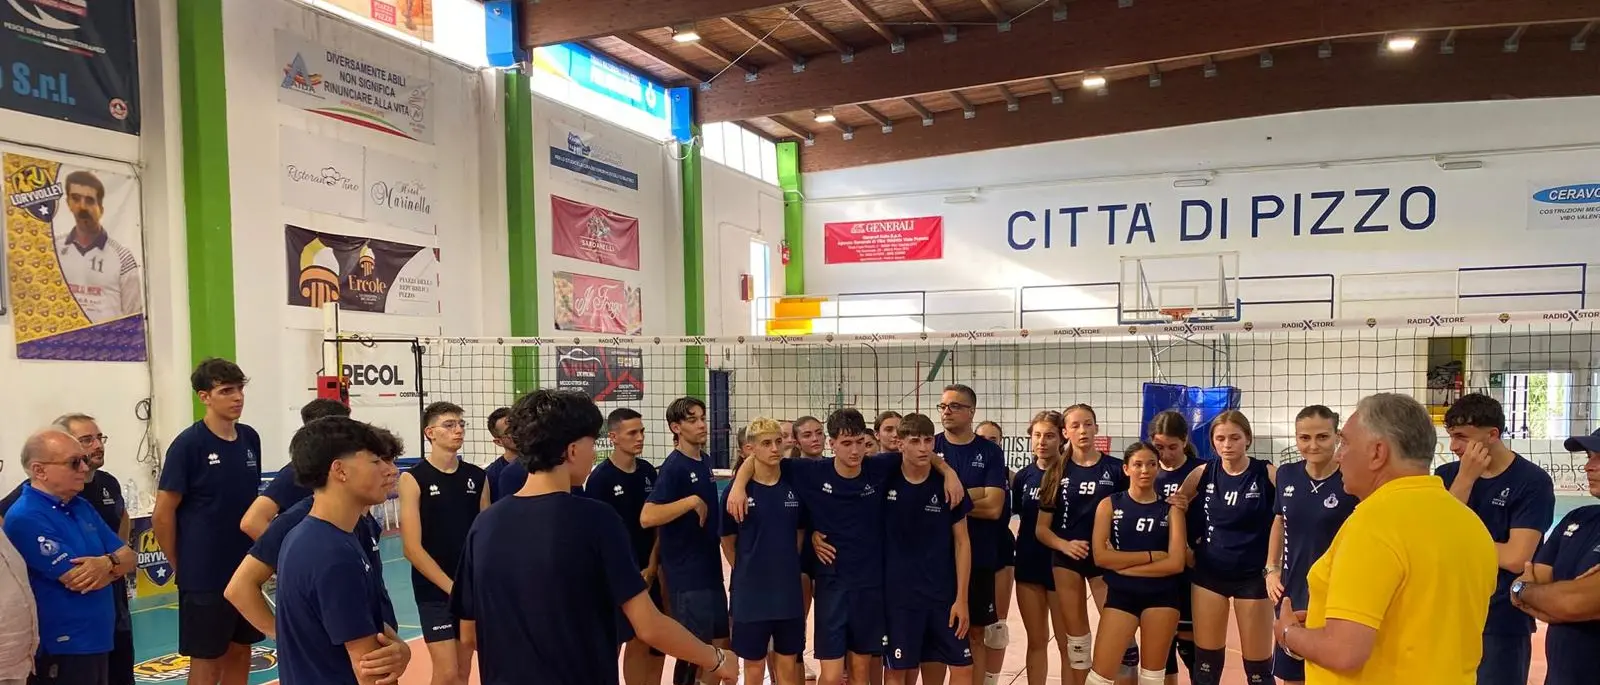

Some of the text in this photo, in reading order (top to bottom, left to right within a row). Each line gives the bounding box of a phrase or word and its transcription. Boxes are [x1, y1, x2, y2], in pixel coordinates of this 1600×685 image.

[326, 50, 406, 88] DIVERSAMENTE ABILI
[12, 61, 77, 106] S.r.l.
[339, 70, 396, 98] NON SIGNIFICA
[324, 80, 373, 103] RINUNCIARE
[373, 97, 393, 112] ALLA
[393, 105, 410, 117] VITA
[9, 183, 63, 206] LORYVOLLEY
[370, 180, 431, 215] Marinella
[1180, 197, 1228, 241] DI
[1251, 185, 1437, 238] PIZZO
[1540, 207, 1585, 215] COSTRUZIONI
[866, 221, 914, 232] GENERALI
[89, 257, 104, 274] 11
[348, 275, 387, 294] Ercole
[1079, 481, 1096, 495] 59
[1164, 484, 1179, 498] 39
[1224, 491, 1238, 506] 41
[1136, 517, 1154, 532] 67
[895, 649, 902, 660] 6
